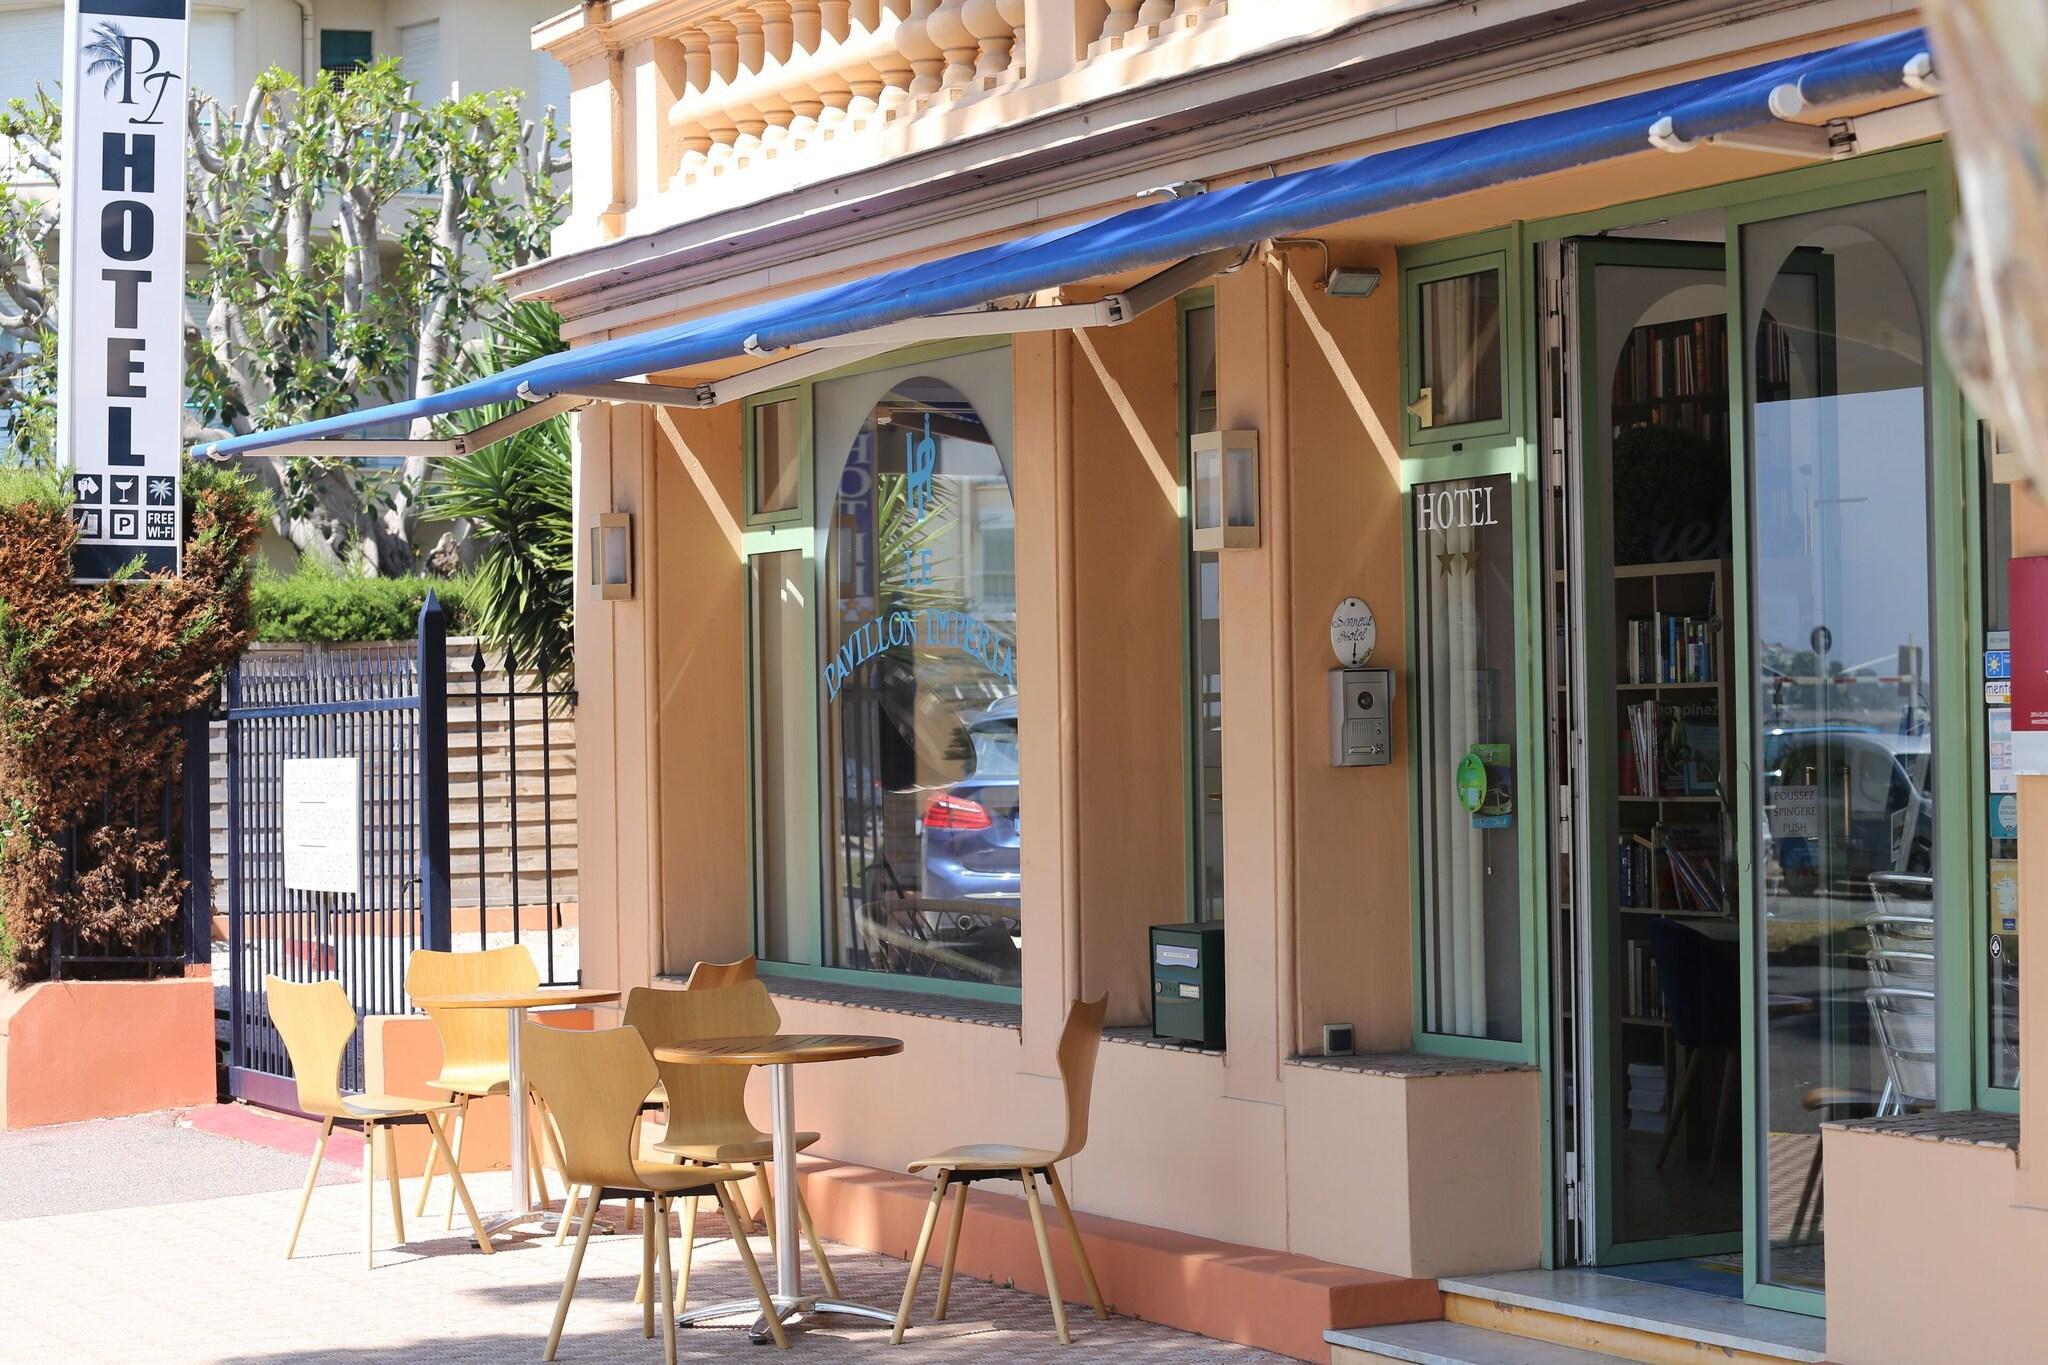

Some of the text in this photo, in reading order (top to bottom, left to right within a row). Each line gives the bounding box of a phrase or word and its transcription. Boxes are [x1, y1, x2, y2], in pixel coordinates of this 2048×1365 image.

[100, 131, 156, 467] HOTEL
[1416, 486, 1499, 531] HOTEL
[147, 512, 174, 525] FREE
[147, 526, 174, 539] WI-FI
[903, 548, 934, 587] LE
[823, 610, 920, 704] PAVILLON
[1774, 790, 1816, 801] POUSSEZ
[1773, 806, 1817, 817] SPINGERE
[1783, 822, 1807, 833] PUSH
